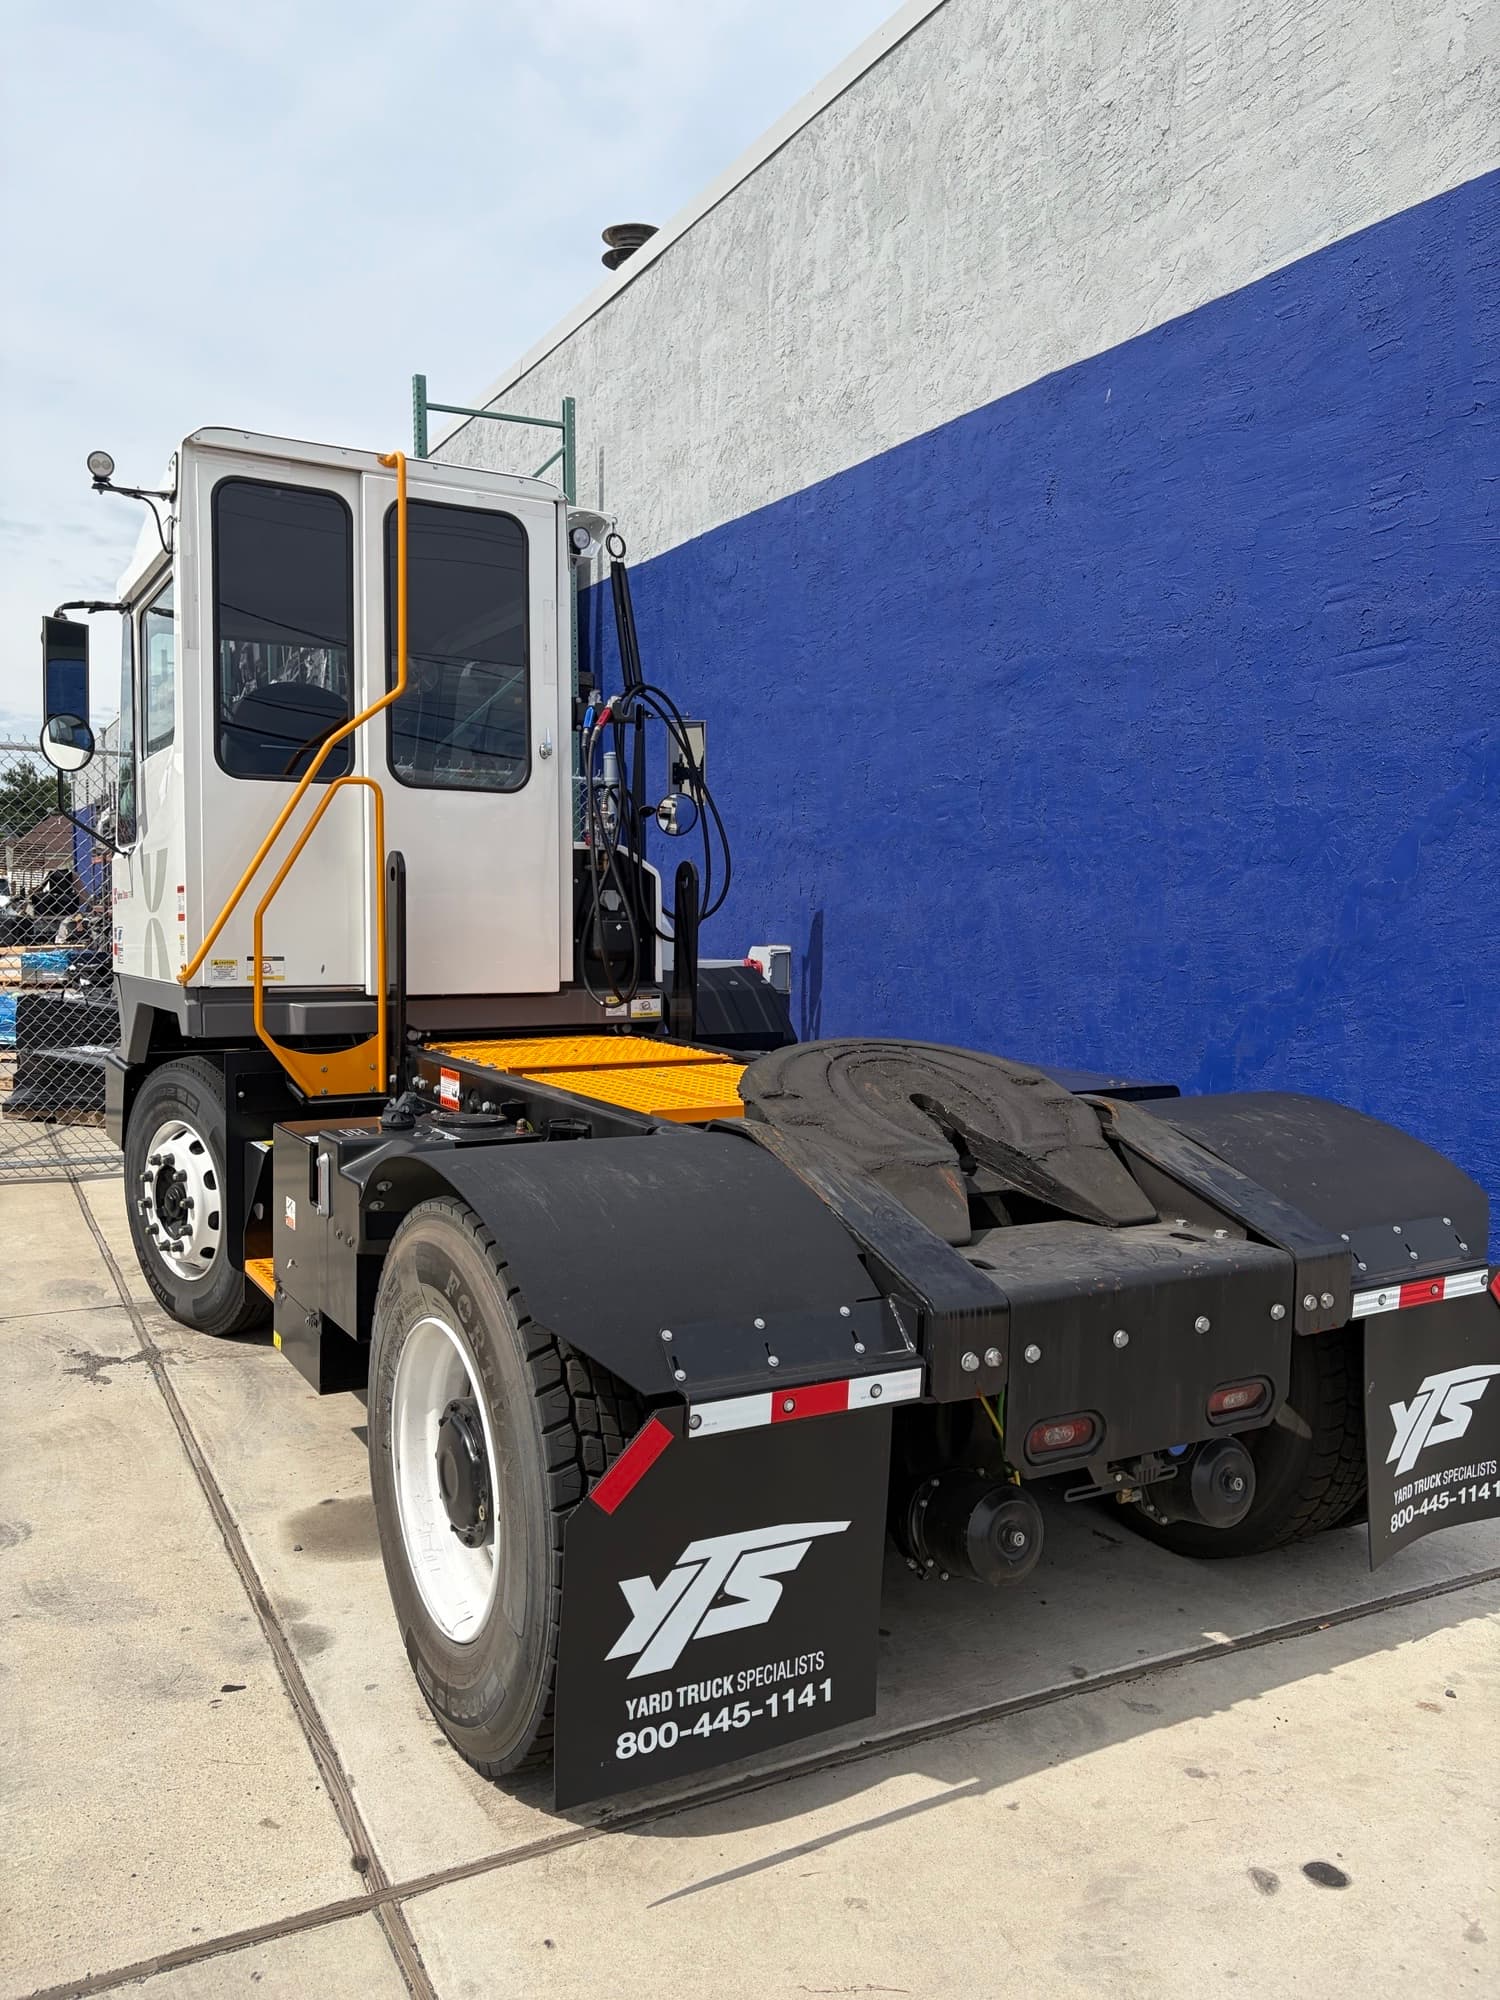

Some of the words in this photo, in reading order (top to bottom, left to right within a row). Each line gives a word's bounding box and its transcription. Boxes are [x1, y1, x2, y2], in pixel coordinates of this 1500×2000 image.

[1385, 1364, 1500, 1478] YTS
[1390, 1480, 1500, 1533] 800-445-1141
[1393, 1483, 1413, 1506] YARD
[1413, 1472, 1442, 1496] TRUCK
[1442, 1459, 1497, 1485] SPECIALISTS
[604, 1520, 852, 1680] YTS
[615, 1678, 832, 1760] 800-445-1141
[625, 1689, 673, 1721] YARD
[676, 1674, 734, 1708] TRUCK
[737, 1650, 825, 1692] SPECIALISTS
